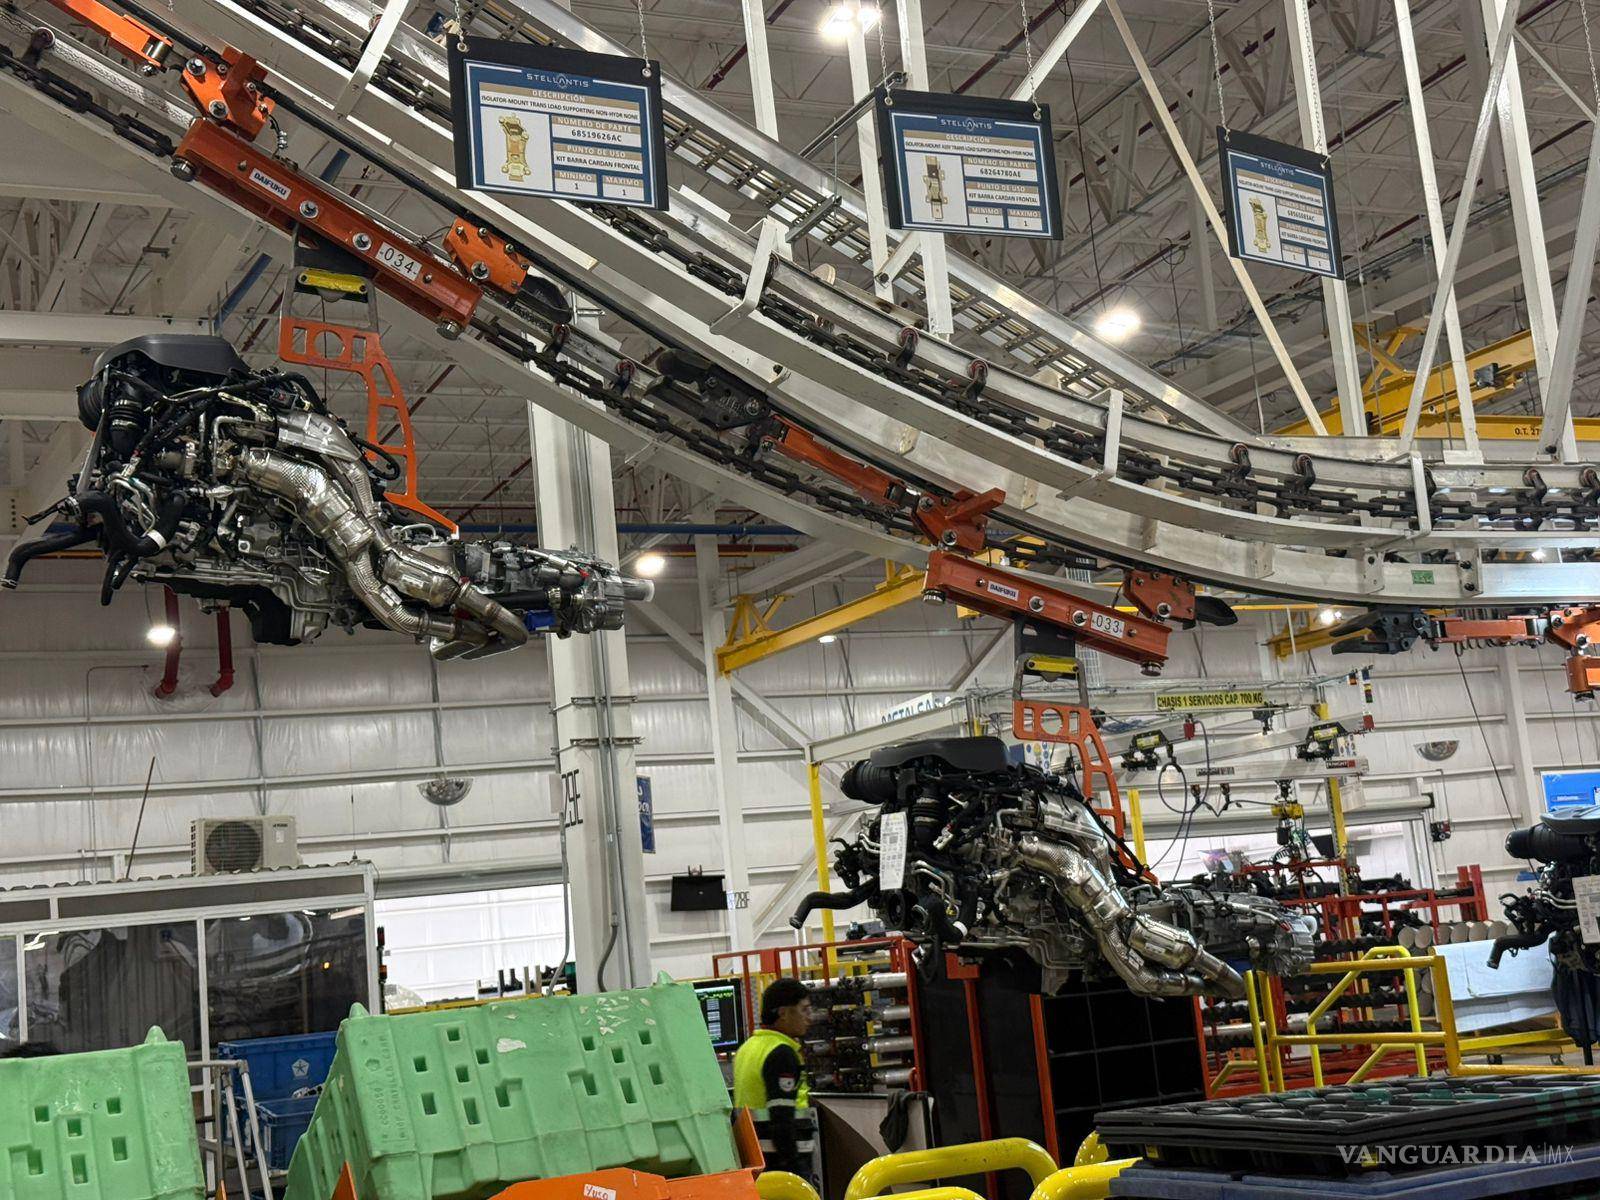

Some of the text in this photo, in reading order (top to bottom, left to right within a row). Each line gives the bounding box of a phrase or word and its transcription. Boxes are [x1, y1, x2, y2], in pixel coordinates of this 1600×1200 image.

[527, 73, 589, 88] STELLANTIS
[530, 101, 546, 109] TRANS
[563, 105, 594, 115] SUPPORTING
[609, 124, 631, 132] PARTE
[941, 119, 992, 130] STELLANTIS
[572, 130, 621, 142] 68519626AC
[567, 145, 594, 154] PUNTO
[610, 150, 625, 158] USO
[589, 159, 613, 167] CARDAN
[614, 162, 640, 170] FRONTAL
[254, 172, 287, 196] DAIFUKU
[1157, 696, 1181, 707] CHASIS
[1183, 696, 1187, 706] 1
[1189, 695, 1223, 706] SERVICIOS
[1240, 693, 1251, 704] 700
[1253, 692, 1262, 703] KG
